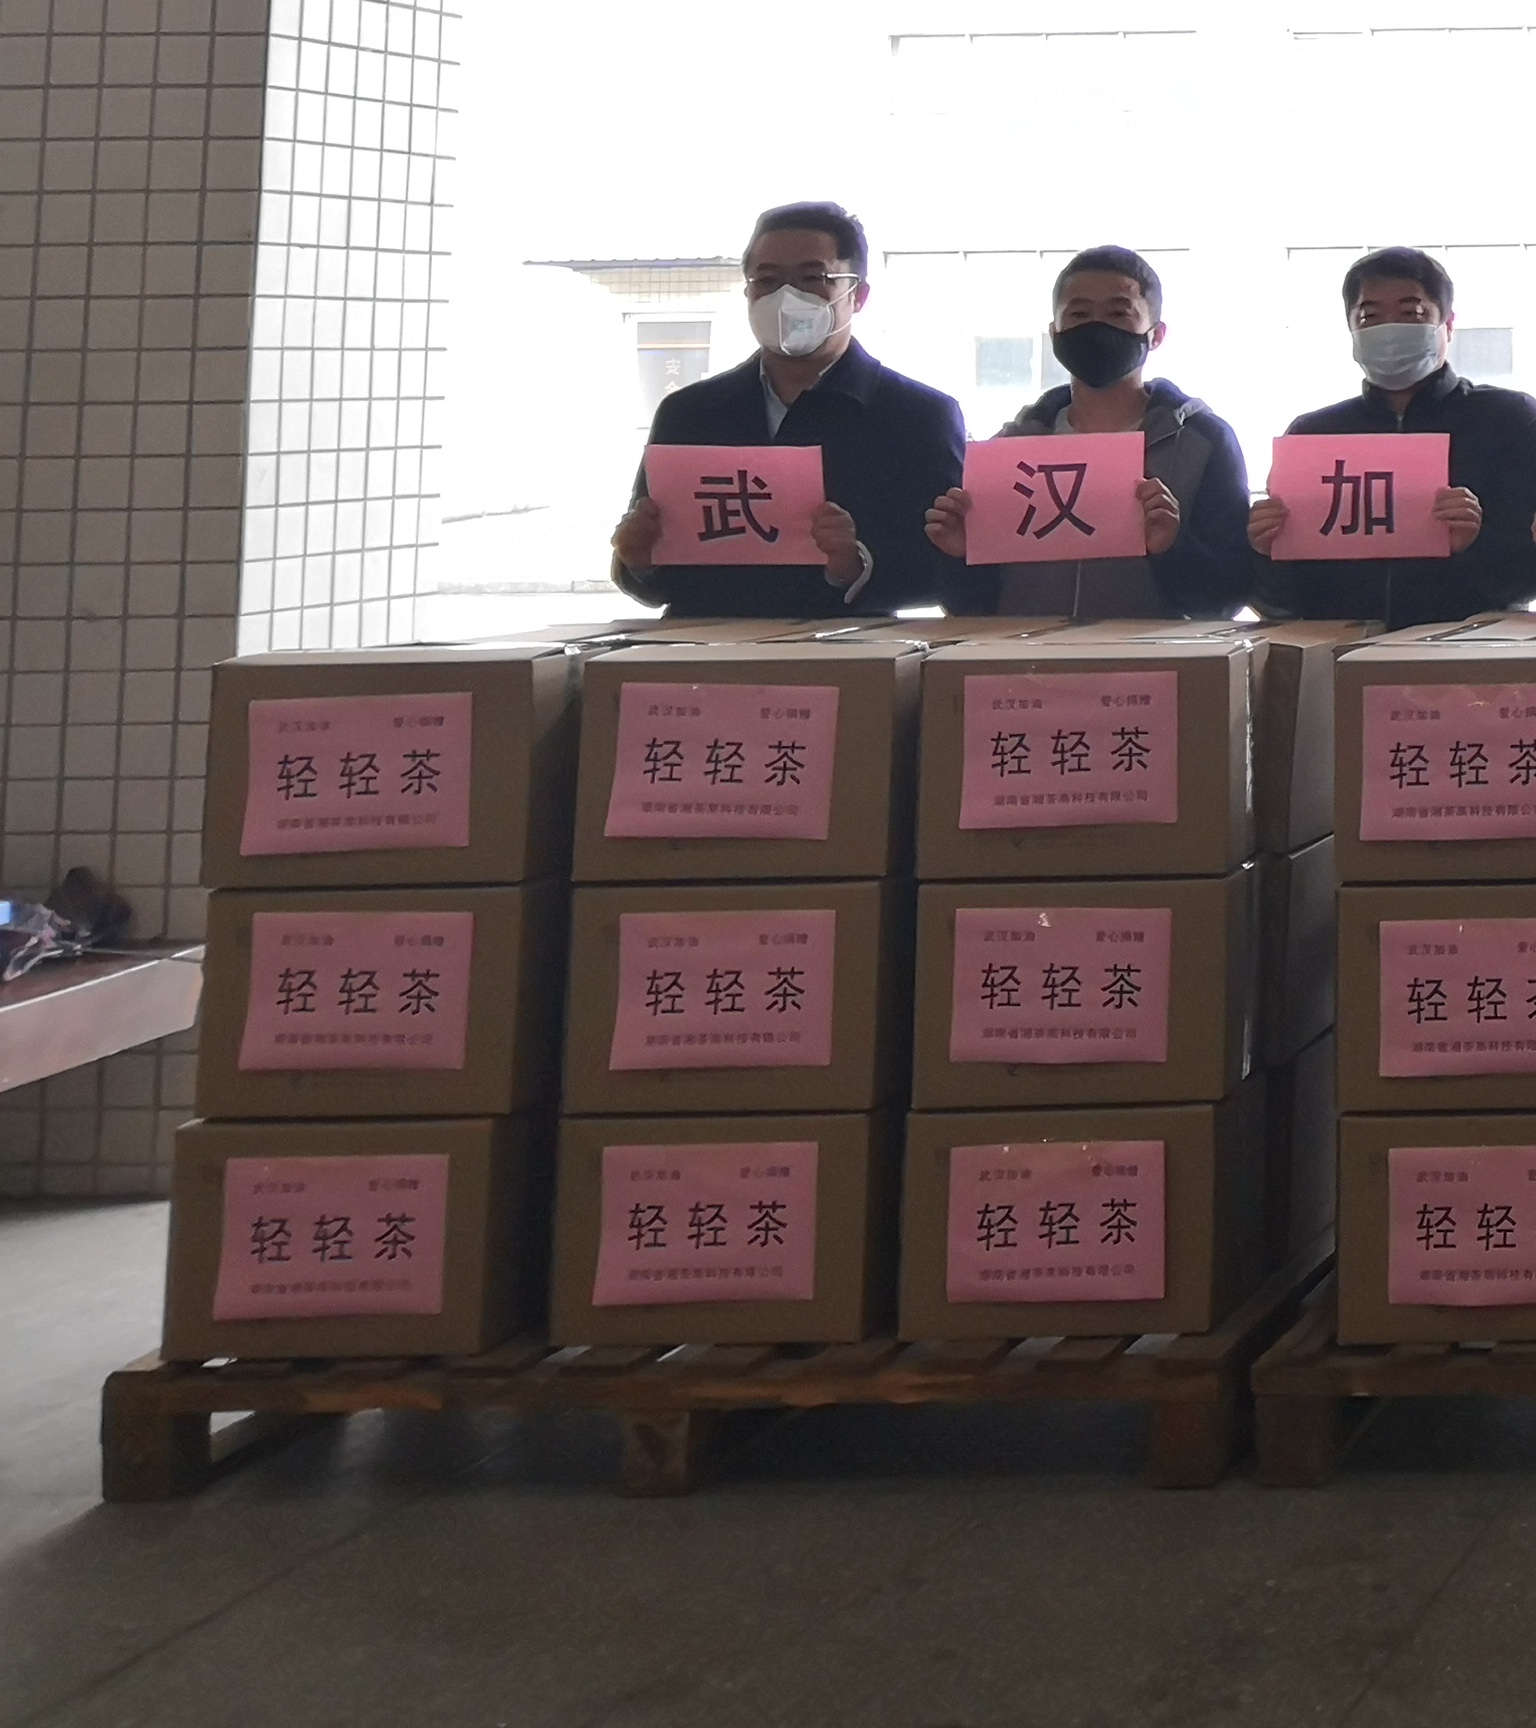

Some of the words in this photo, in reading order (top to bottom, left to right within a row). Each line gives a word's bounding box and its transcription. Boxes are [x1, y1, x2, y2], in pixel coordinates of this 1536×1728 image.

[693, 469, 780, 544] 武
[1012, 461, 1096, 540] 汉
[1318, 459, 1396, 537] 加
[276, 748, 441, 801] 轻轻茶
[642, 737, 807, 787] 轻轻茶
[990, 726, 1151, 778] 轻轻茶
[276, 967, 440, 1016] 轻轻茶
[645, 966, 805, 1017] 轻轻茶
[980, 962, 1142, 1011] 轻轻茶
[250, 1212, 416, 1263] 轻轻茶
[627, 1200, 788, 1251] 轻轻茶
[976, 1197, 1138, 1252] 轻轻茶
